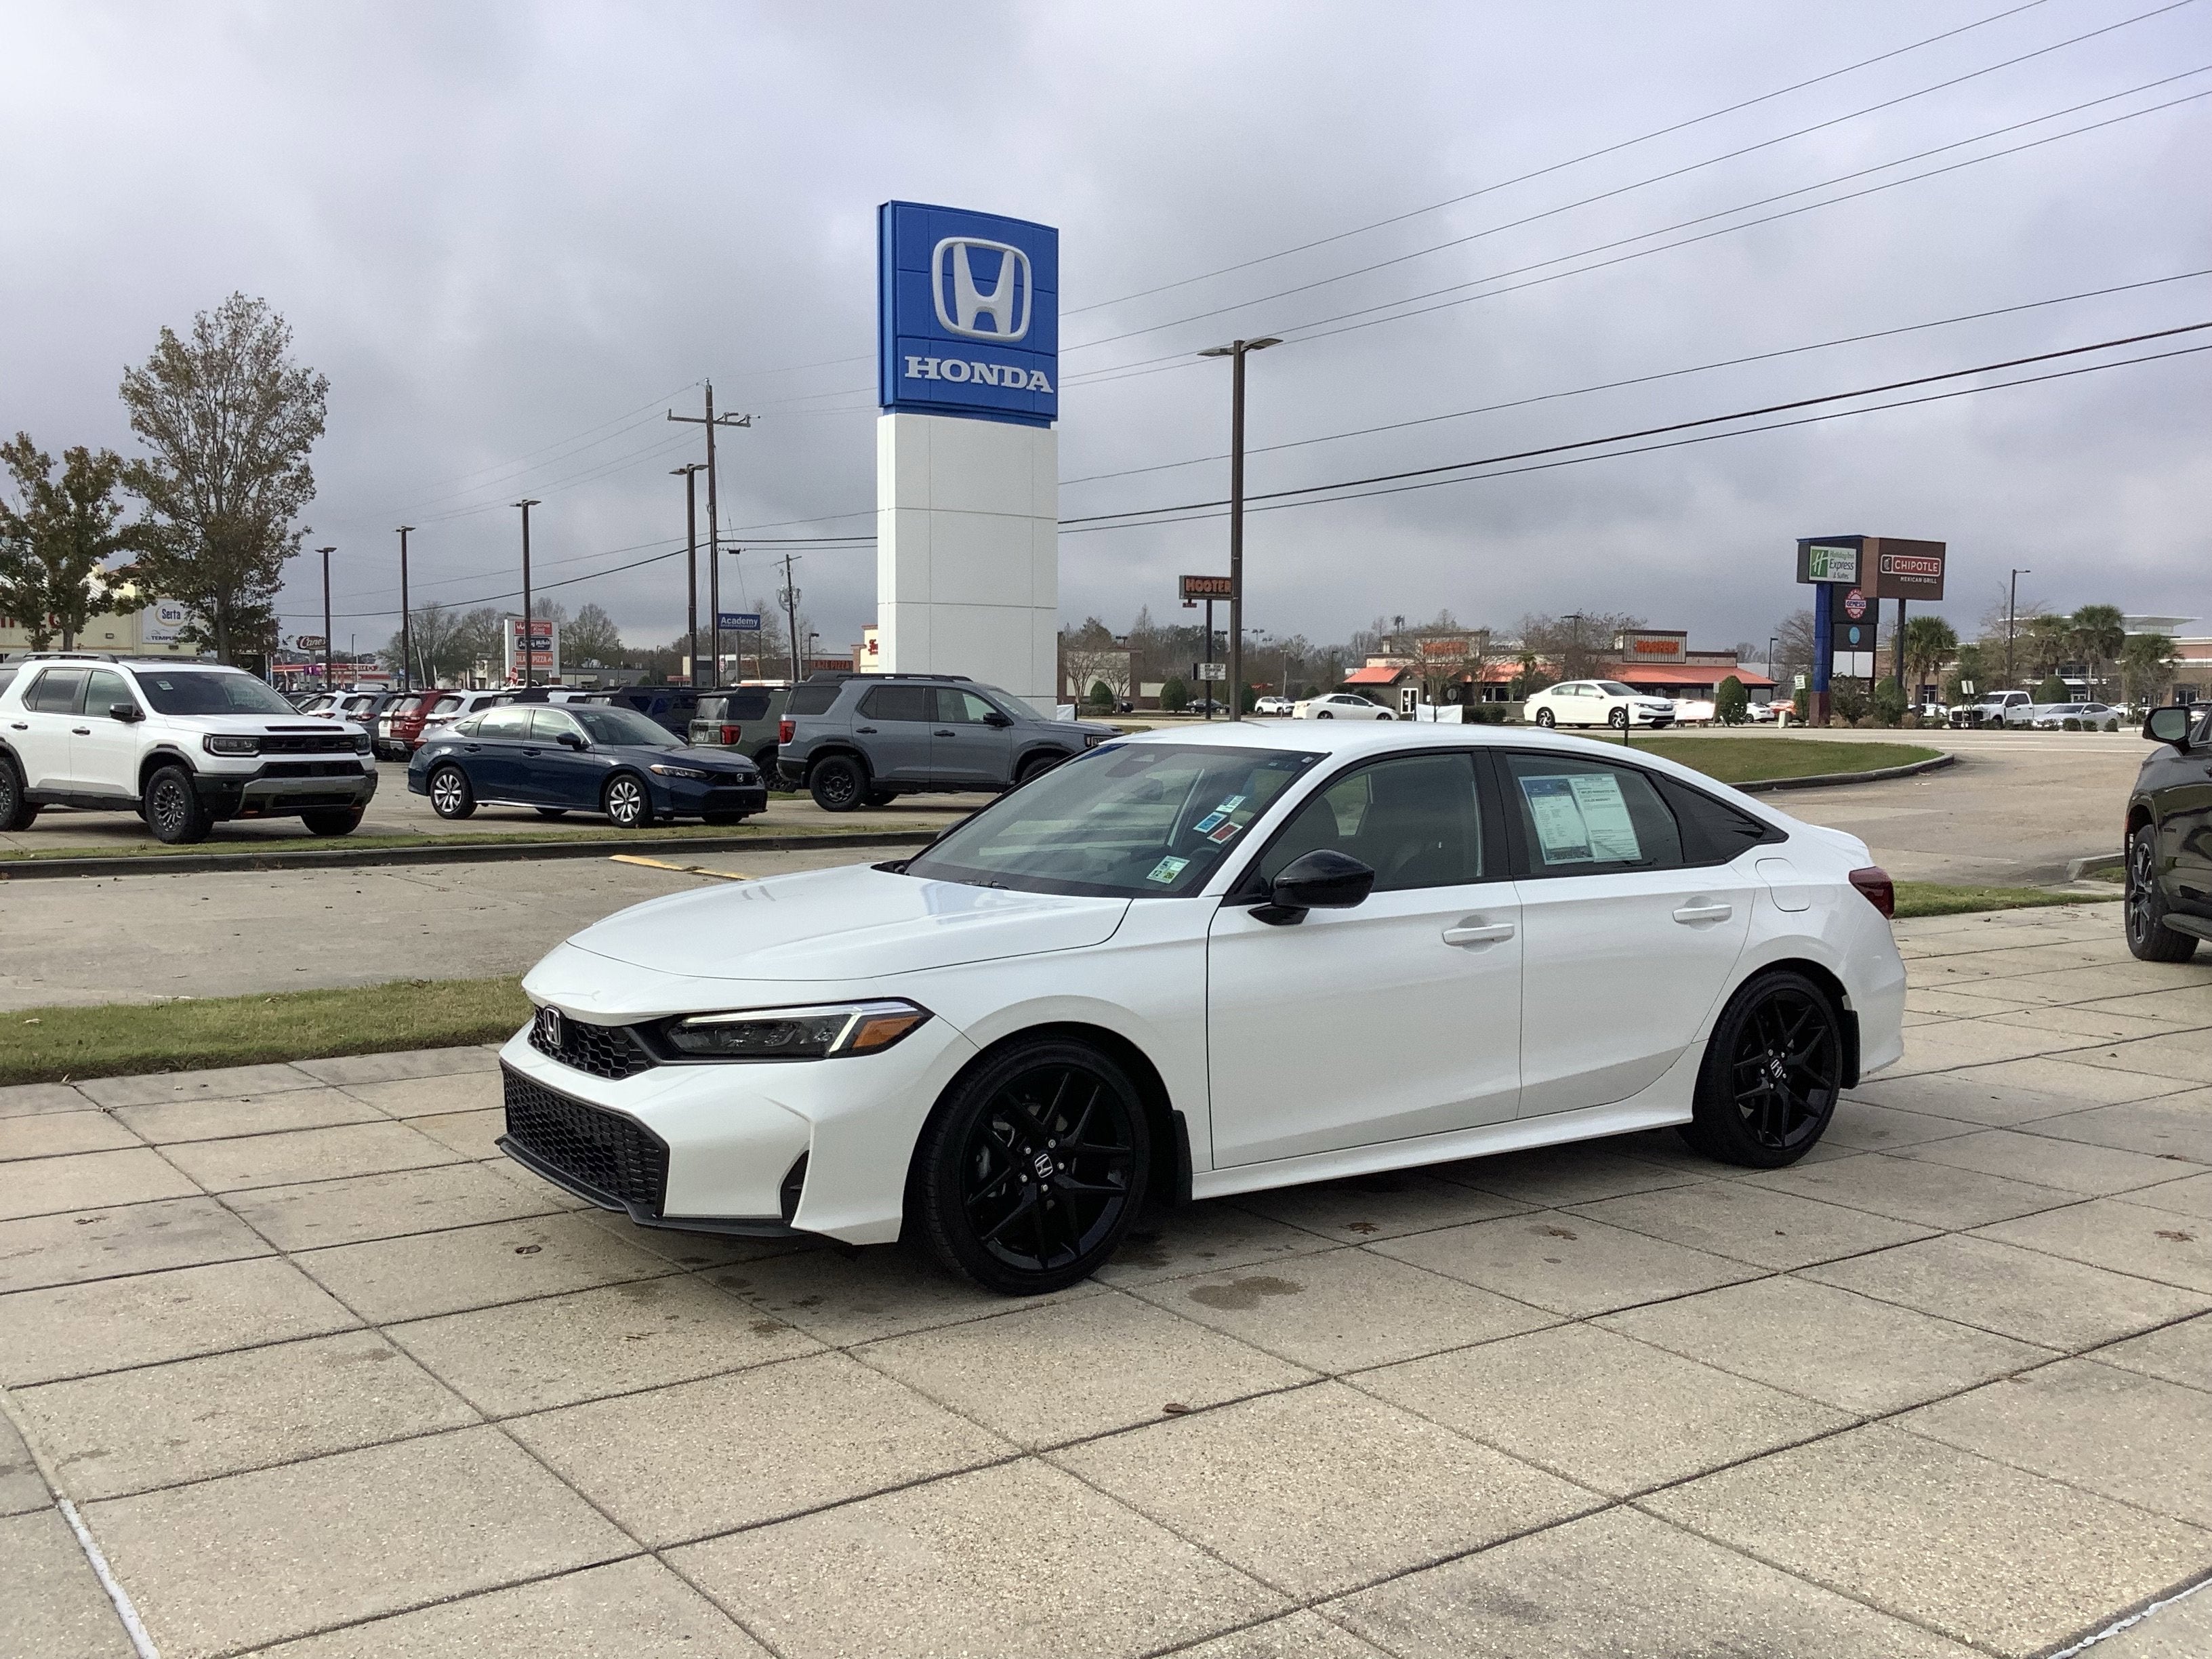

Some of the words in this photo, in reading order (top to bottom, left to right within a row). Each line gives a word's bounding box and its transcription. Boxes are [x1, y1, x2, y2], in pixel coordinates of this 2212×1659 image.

[905, 356, 1054, 393] HONDA
[1829, 558, 1854, 571] Express
[1895, 560, 1938, 572] CHIPOTLE
[1185, 578, 1232, 593] HOOTER
[162, 609, 181, 619] Serta
[720, 617, 758, 627] Academy
[300, 637, 325, 649] Cane's
